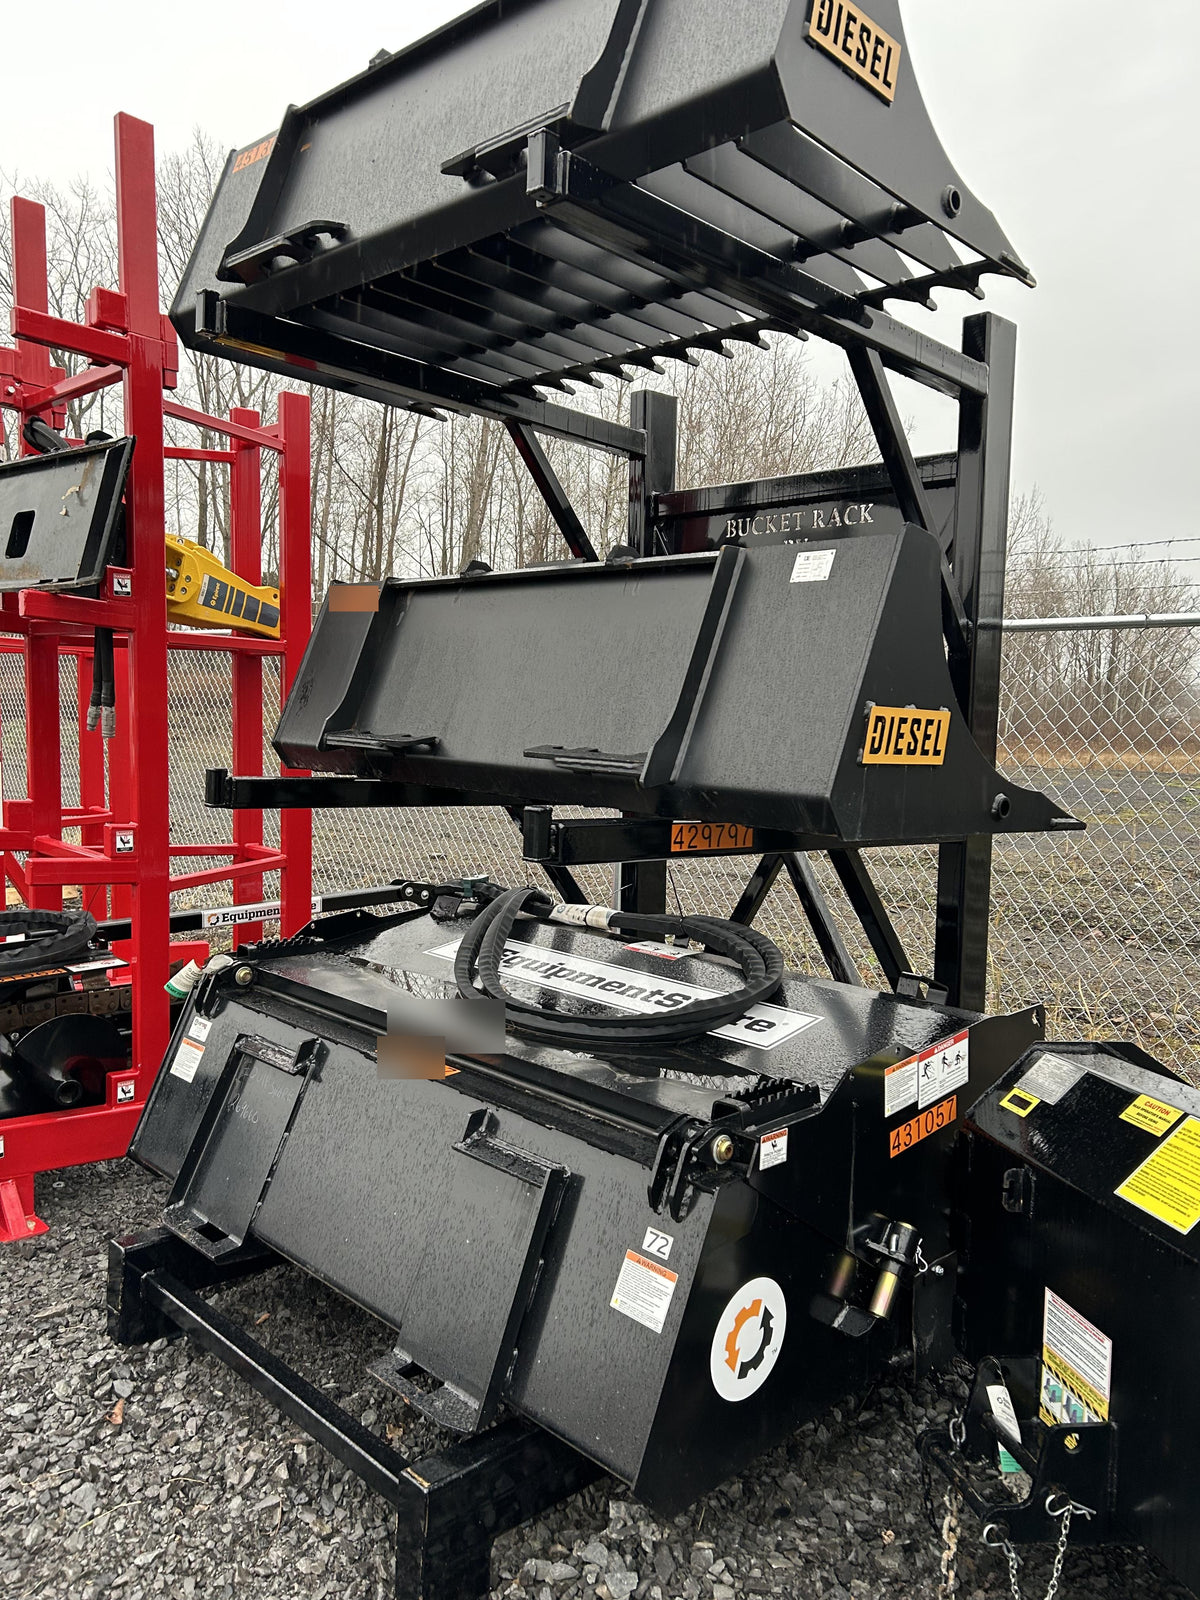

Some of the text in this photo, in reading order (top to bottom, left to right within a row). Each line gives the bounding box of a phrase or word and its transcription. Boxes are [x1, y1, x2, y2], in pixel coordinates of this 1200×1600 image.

[816, 0, 892, 90] DIESEL
[726, 503, 874, 538] BUCKET RACK
[869, 715, 942, 756] DIESEL
[673, 824, 750, 849] 429797
[1144, 1101, 1171, 1116] CAUTION
[892, 1098, 955, 1152] 431057
[647, 1230, 669, 1256] 72
[641, 1260, 667, 1277] WARNING
